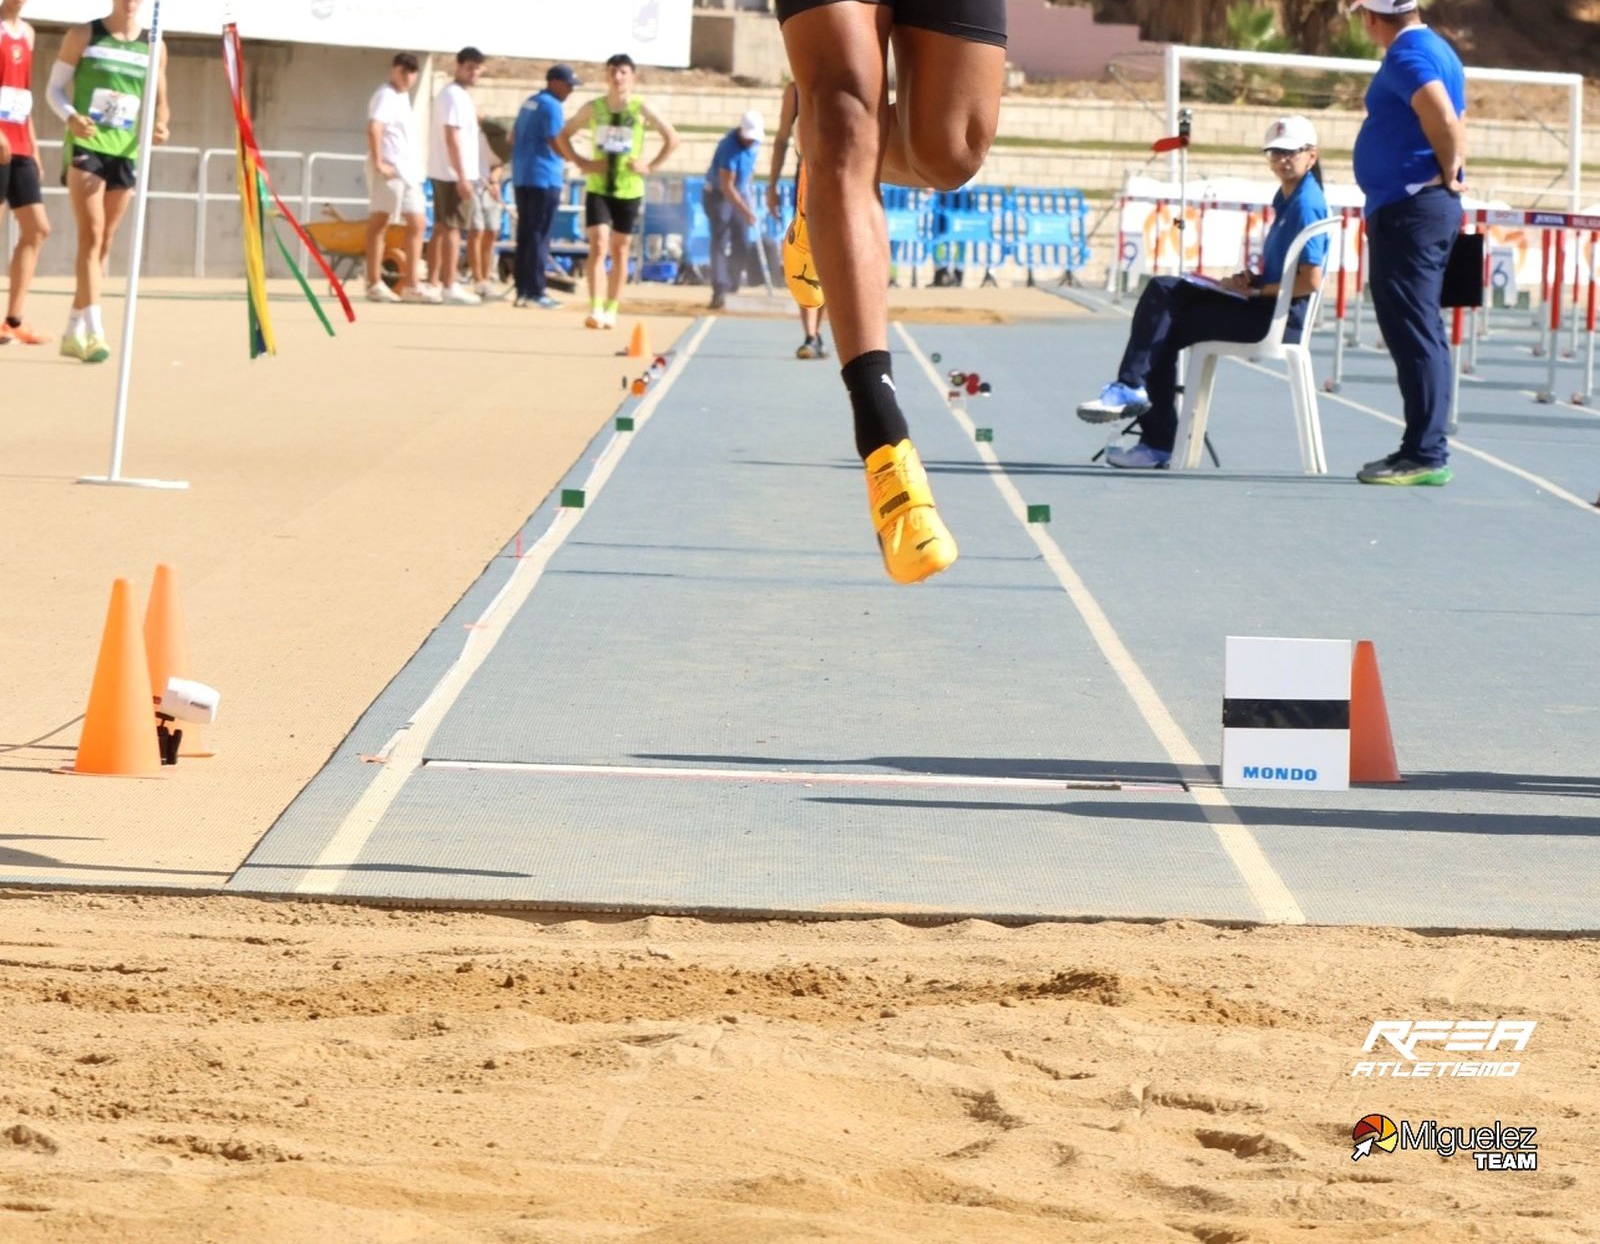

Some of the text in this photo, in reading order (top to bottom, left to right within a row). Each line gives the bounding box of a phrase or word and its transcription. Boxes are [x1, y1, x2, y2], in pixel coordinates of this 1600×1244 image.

[1122, 241, 1138, 269] 9
[1492, 260, 1509, 288] 6
[1243, 766, 1318, 781] MONDO
